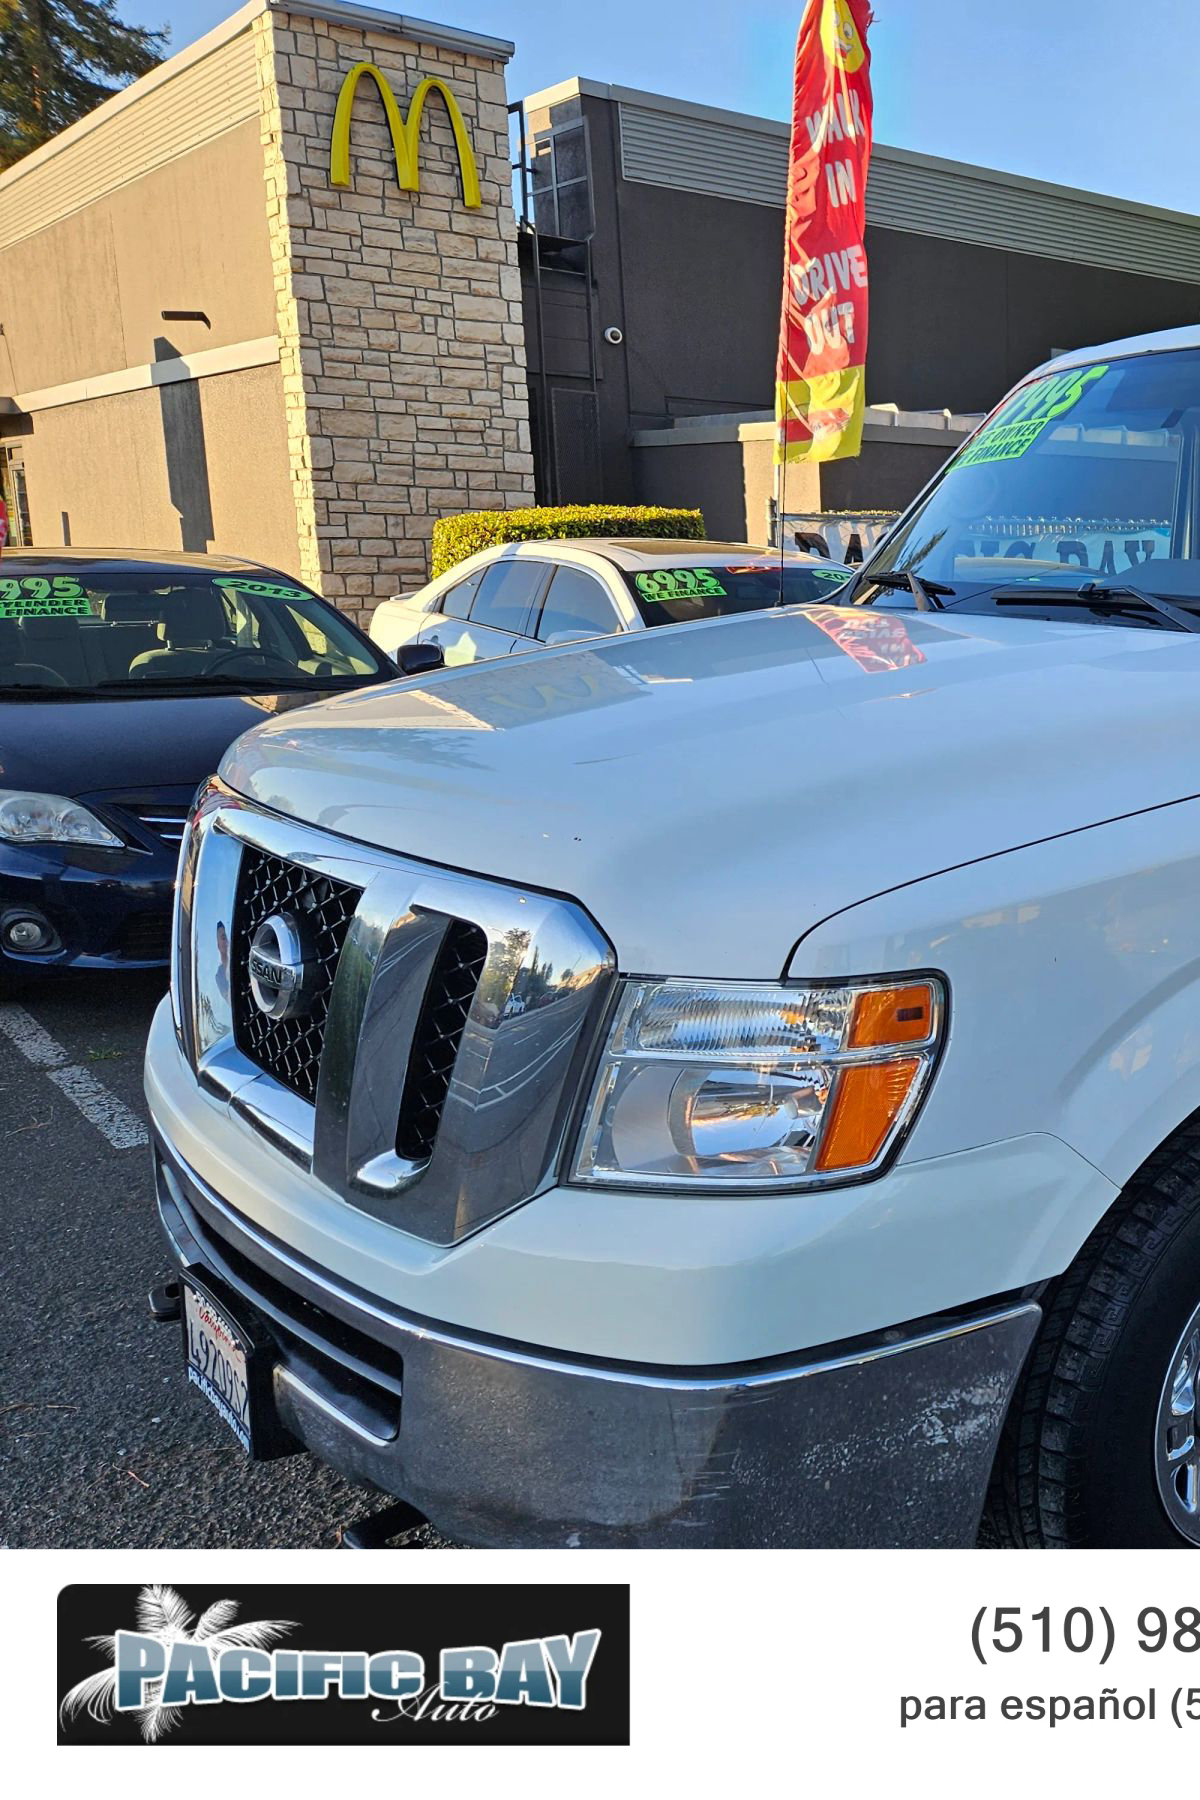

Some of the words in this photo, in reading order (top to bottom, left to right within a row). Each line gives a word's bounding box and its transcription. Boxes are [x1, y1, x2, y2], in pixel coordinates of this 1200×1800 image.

[806, 89, 866, 147] WALK
[826, 159, 857, 208] IN
[790, 244, 868, 305] DRIVE
[804, 302, 855, 354] OUT
[991, 420, 1046, 443] OWNER
[226, 580, 302, 598] 2013
[635, 568, 720, 593] 6995
[2, 599, 87, 609] YLINDER
[644, 592, 665, 601] WE
[667, 586, 723, 598] FINANCE
[5, 606, 89, 617] FINANCE
